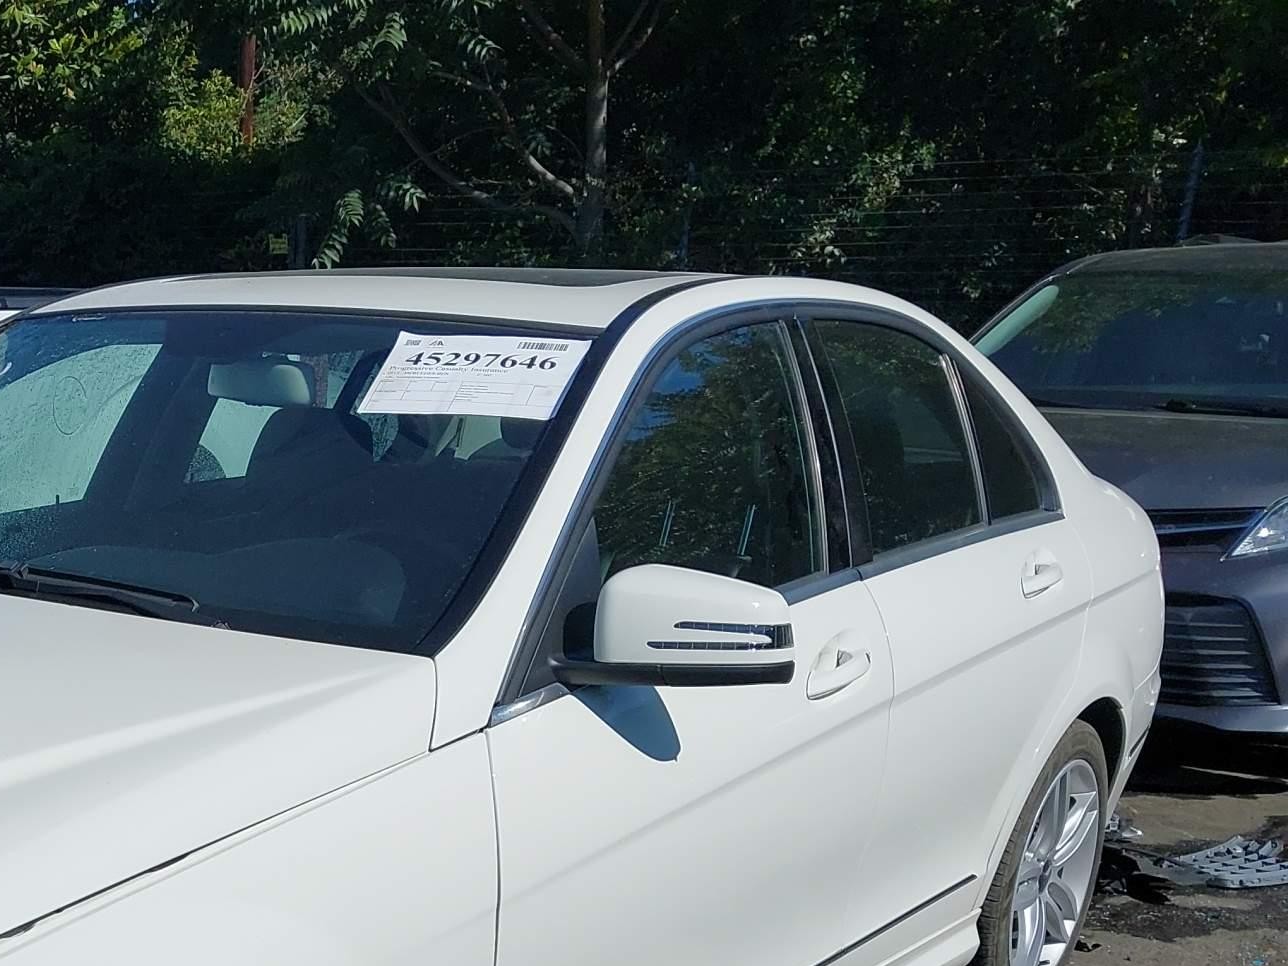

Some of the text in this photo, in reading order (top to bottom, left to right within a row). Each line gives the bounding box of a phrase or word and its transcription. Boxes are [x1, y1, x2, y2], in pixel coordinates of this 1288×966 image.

[405, 351, 558, 370] 45297646
[389, 365, 434, 374] Progressive
[434, 366, 469, 374] Casualty
